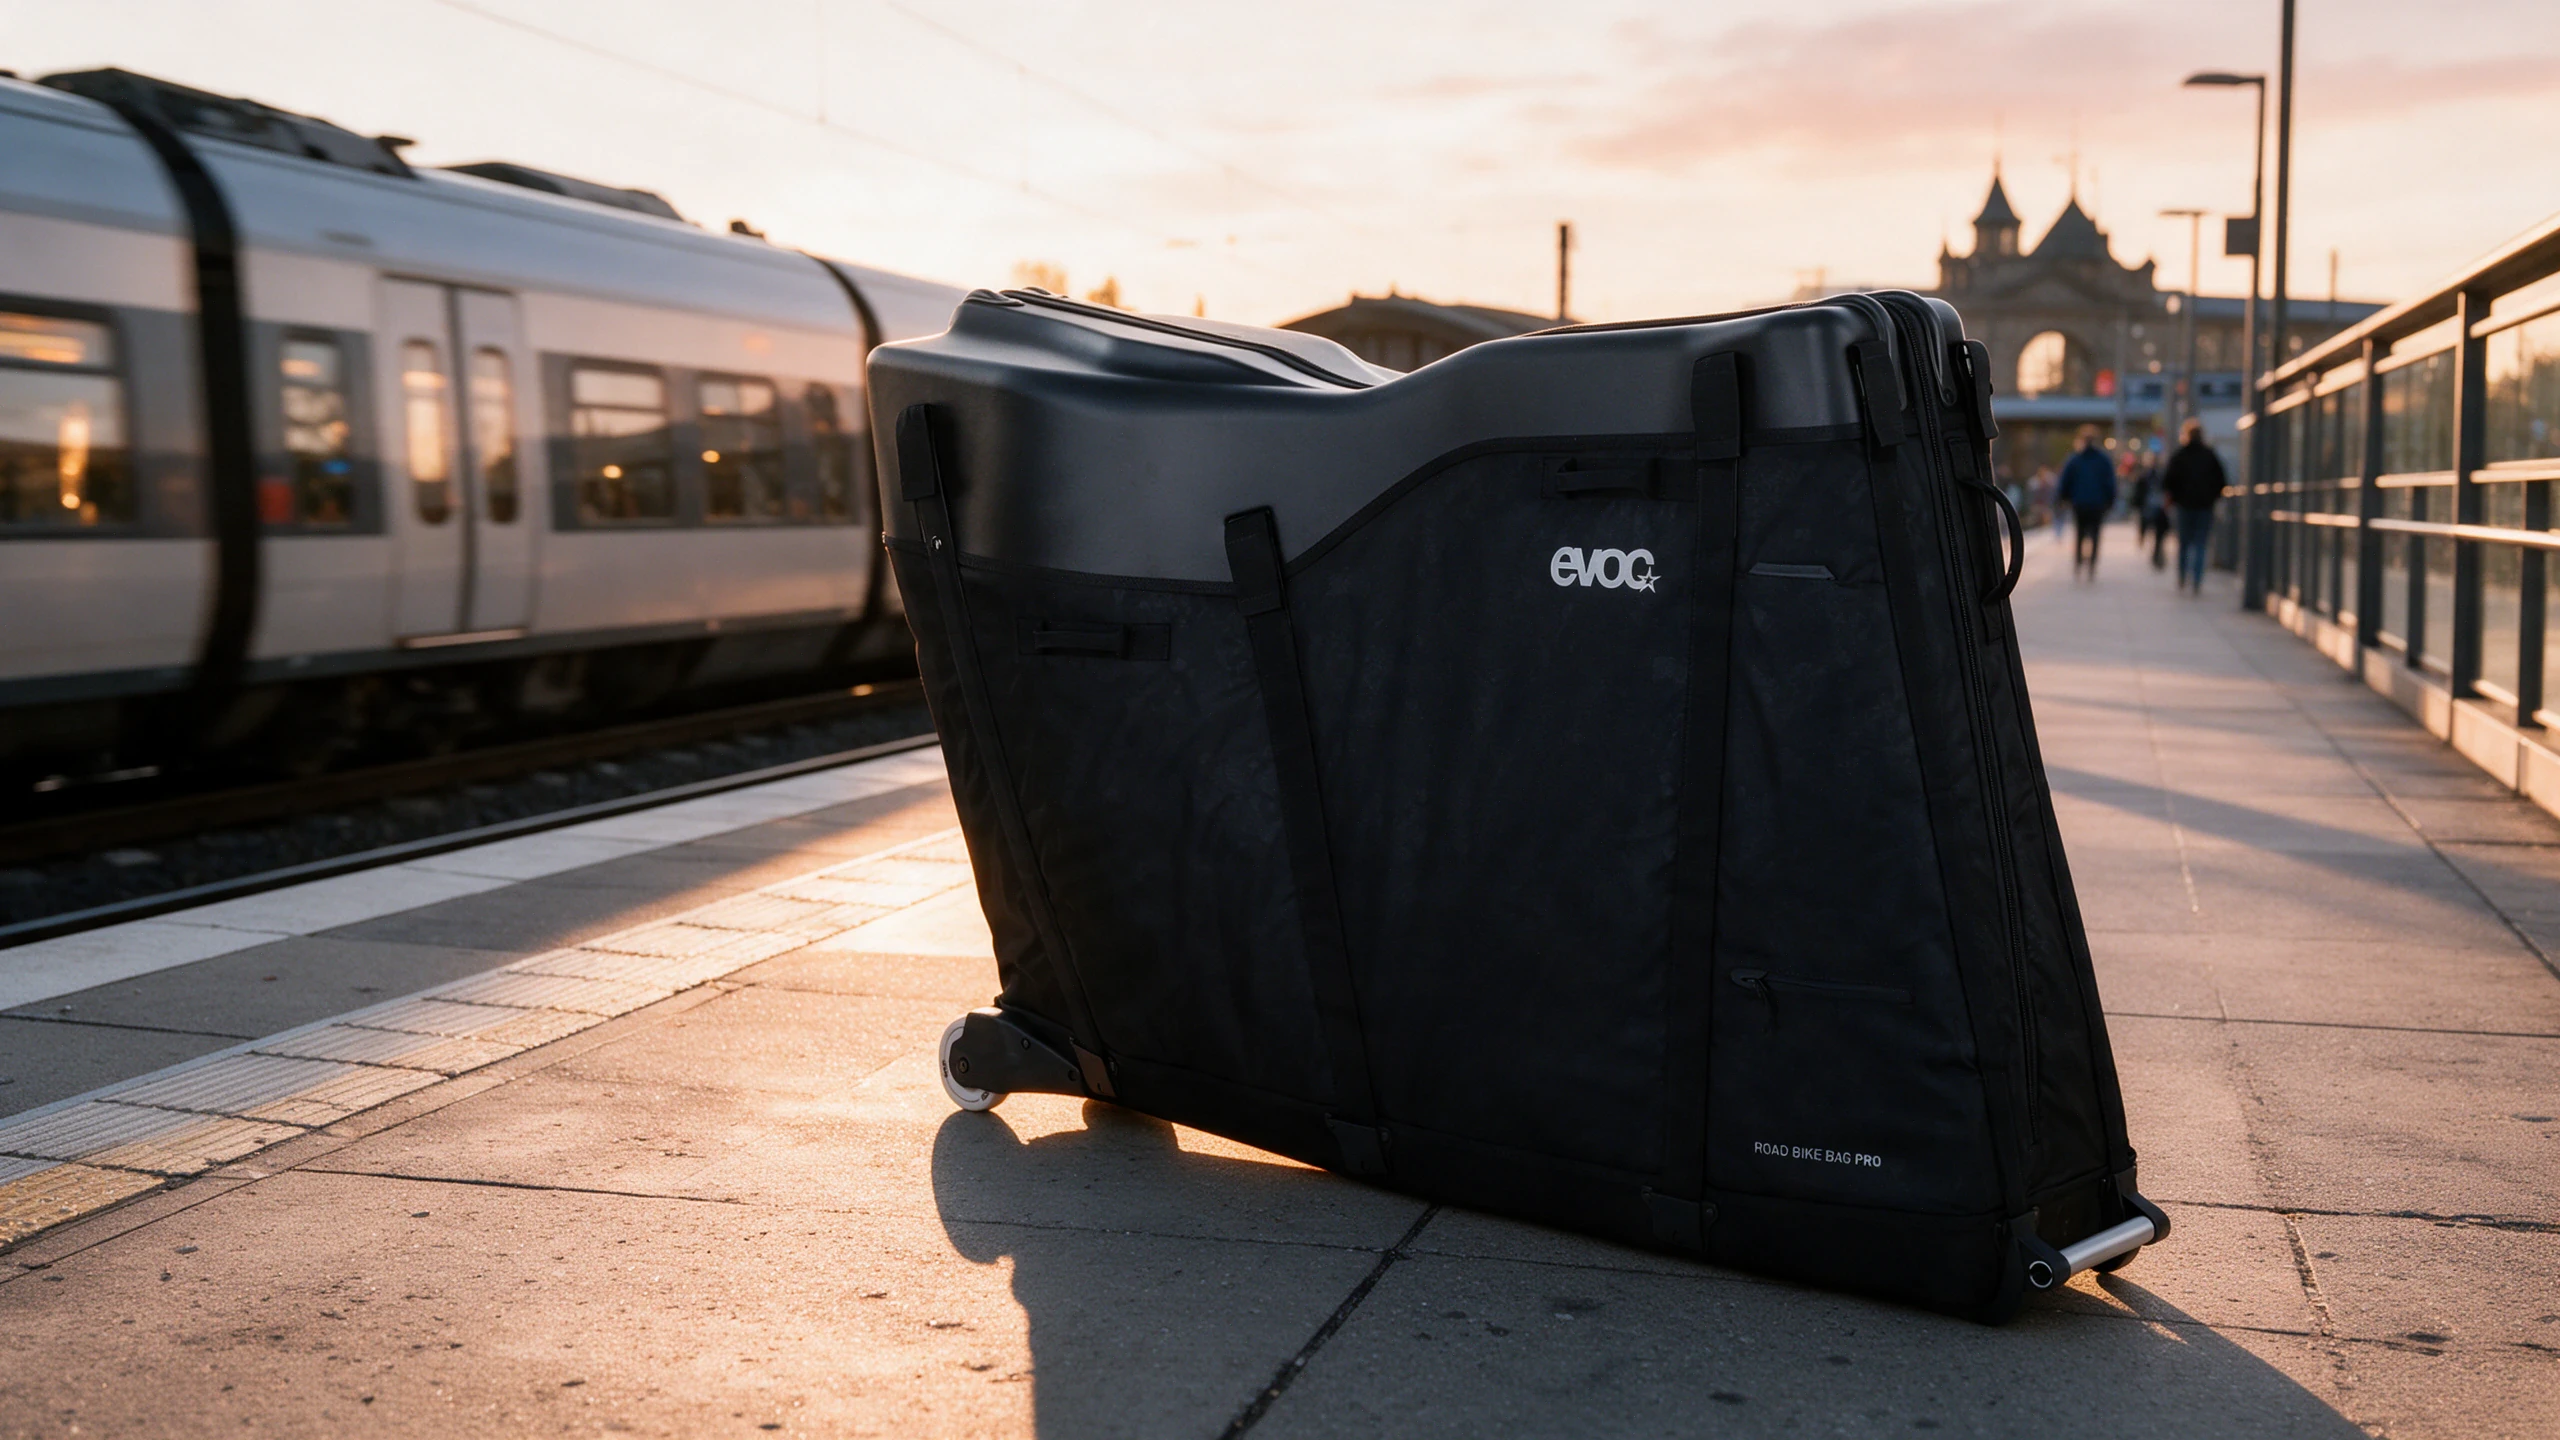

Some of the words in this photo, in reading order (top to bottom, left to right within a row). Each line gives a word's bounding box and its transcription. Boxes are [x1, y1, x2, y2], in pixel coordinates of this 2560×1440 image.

[1550, 546, 1656, 591] evoc
[1754, 1141, 1789, 1157] ROAD
[1792, 1146, 1823, 1162] BIKE
[1825, 1149, 1852, 1165] BAG
[1854, 1153, 1882, 1168] PRO
